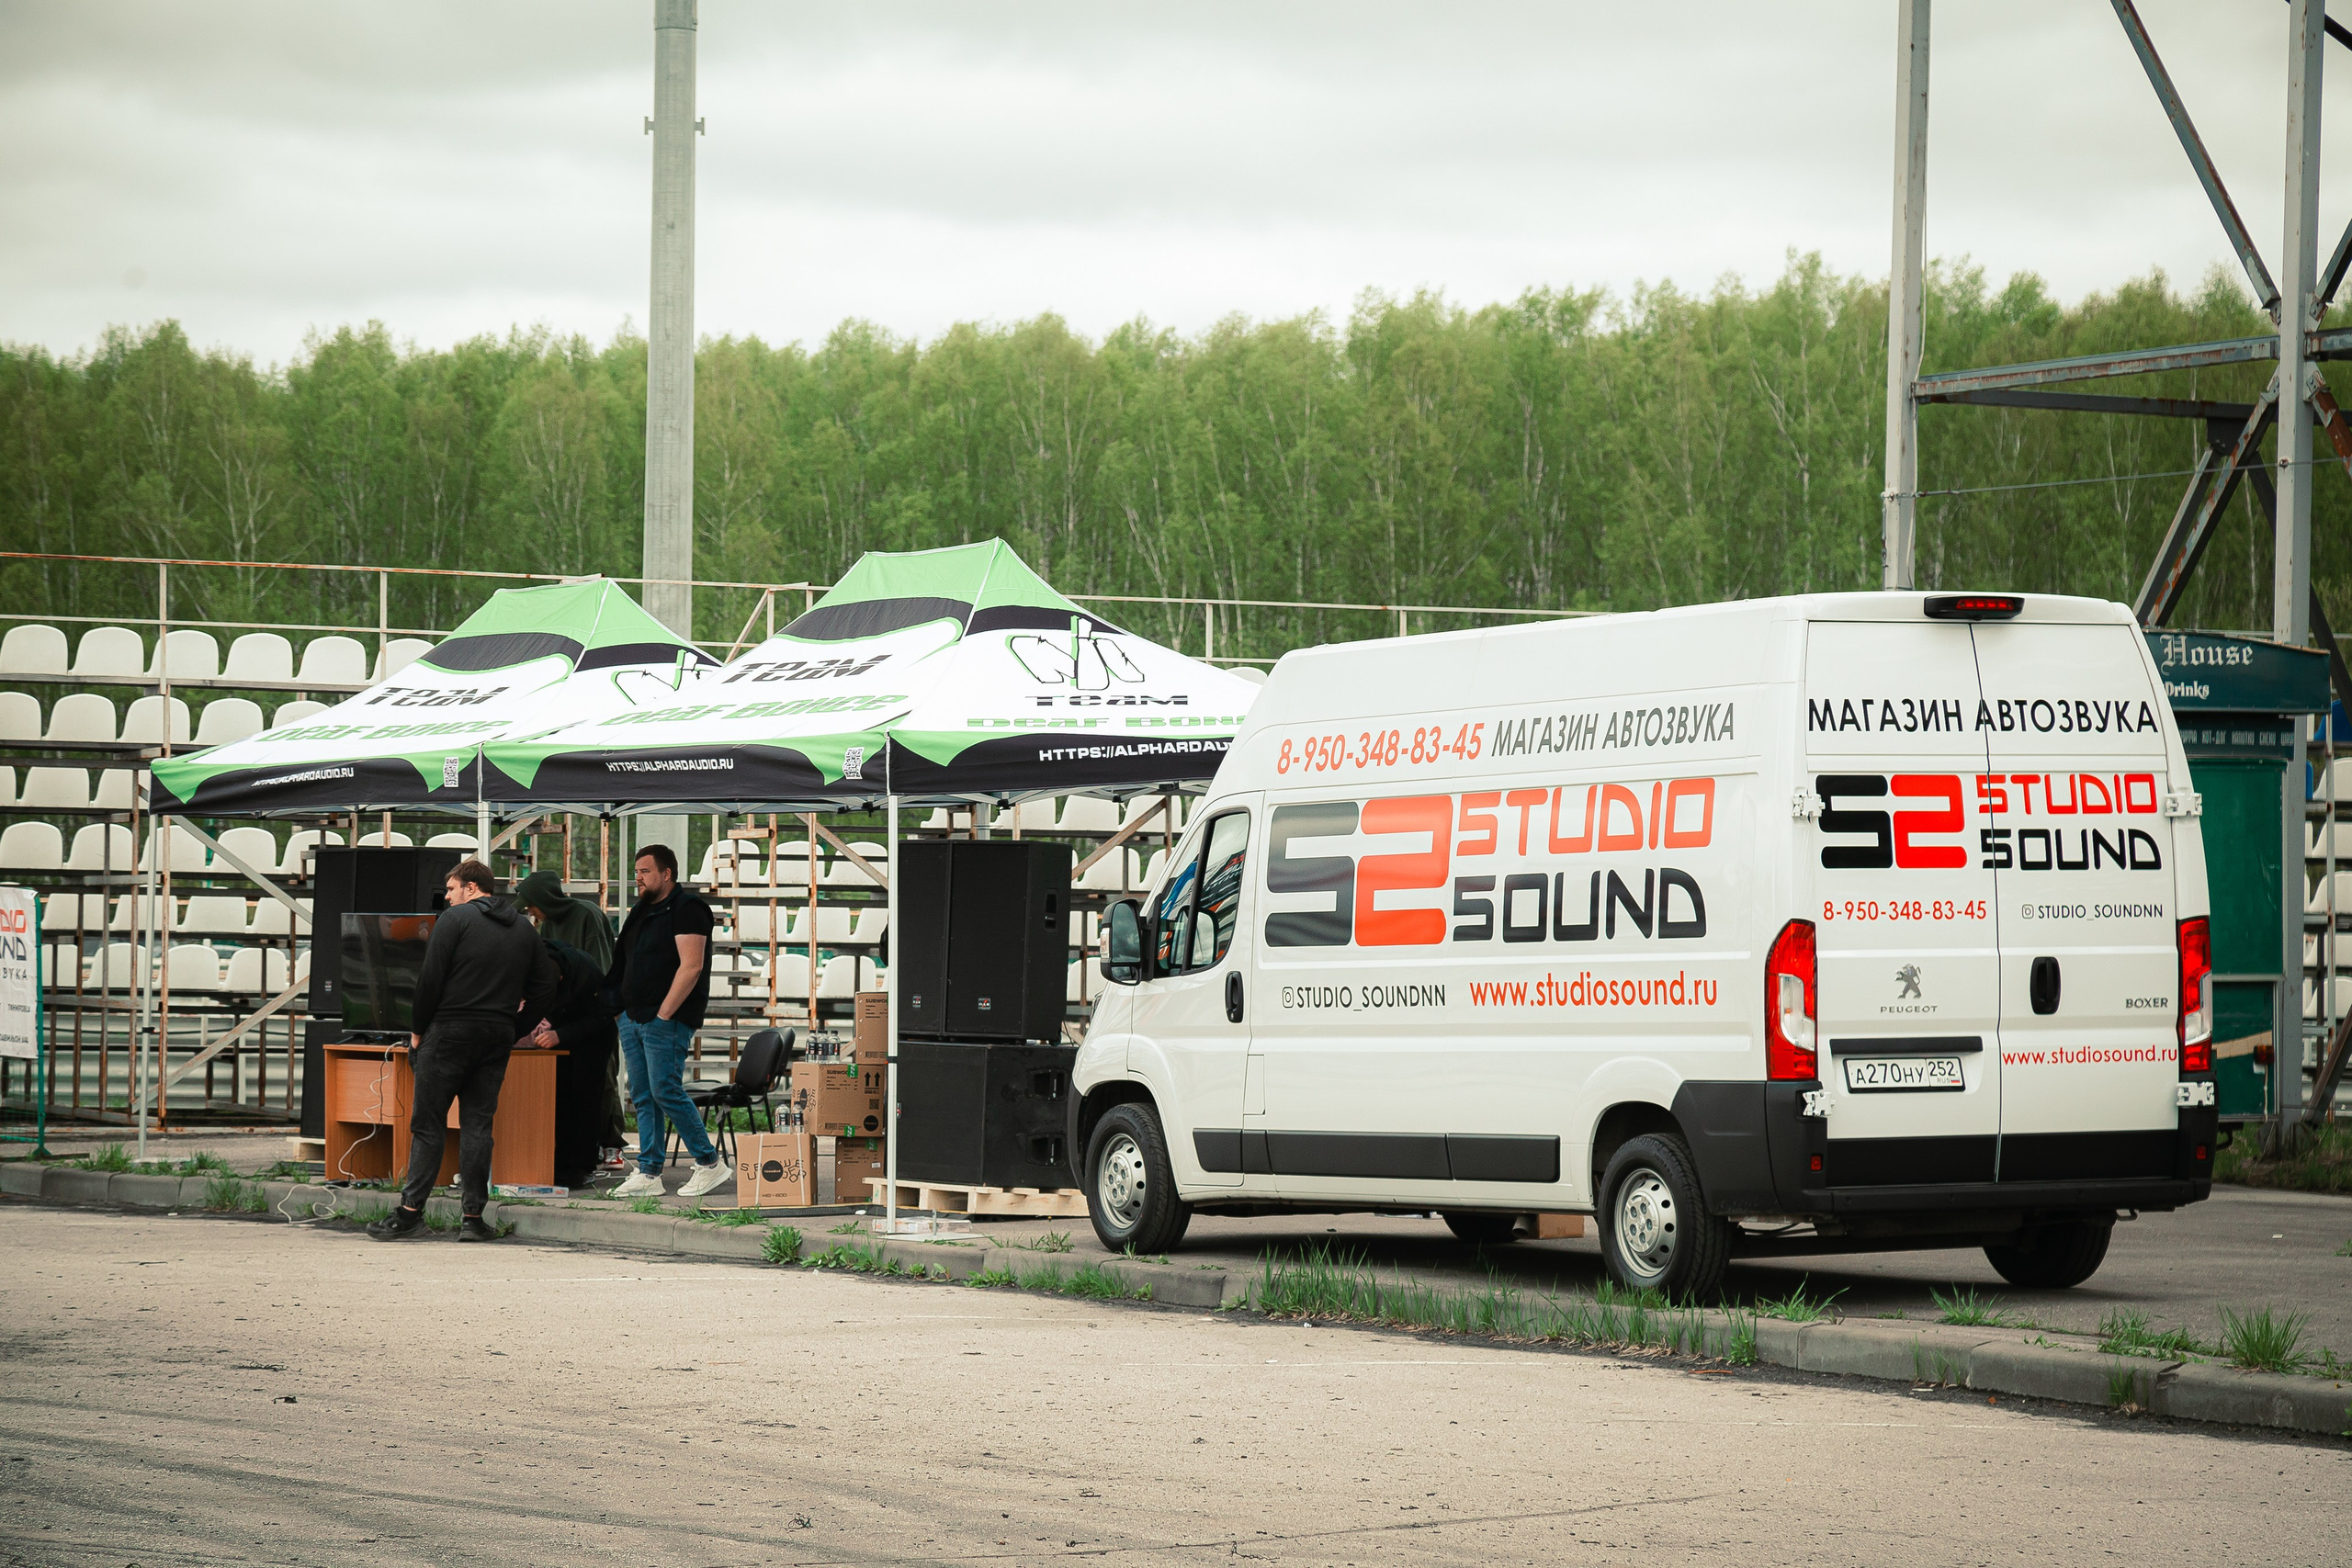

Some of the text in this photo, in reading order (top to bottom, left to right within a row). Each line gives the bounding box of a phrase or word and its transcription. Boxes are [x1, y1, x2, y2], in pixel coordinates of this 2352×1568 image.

[2160, 634, 2254, 676] House
[2165, 681, 2210, 700] Drinks
[1808, 699, 2158, 733] МАГАЗИН АВТОЗВУКА
[1277, 702, 1735, 774] 8-950-348-83-45 МАГАЗИН АВТОЗВУКА
[608, 758, 734, 773] HTTPS://ALPHARDAUDIO.RU
[1975, 773, 2157, 815] STUDIO
[1456, 777, 1715, 857] STUDIO
[1980, 829, 2162, 871] SOUND
[1453, 867, 1706, 942] SOUND
[1823, 900, 1987, 920] 8-950-348-83-45
[2038, 904, 2163, 921] STUDIO_SOUNDNN
[0, 936, 27, 961] ND
[1296, 984, 1446, 1012] STUDIO_SOUNDNN
[1470, 970, 1717, 1008] www.studiosound.ru
[1880, 1005, 1939, 1013] PEUGEOT
[2125, 998, 2168, 1010] BOXER
[2003, 1045, 2177, 1066] www.studiosound.ru
